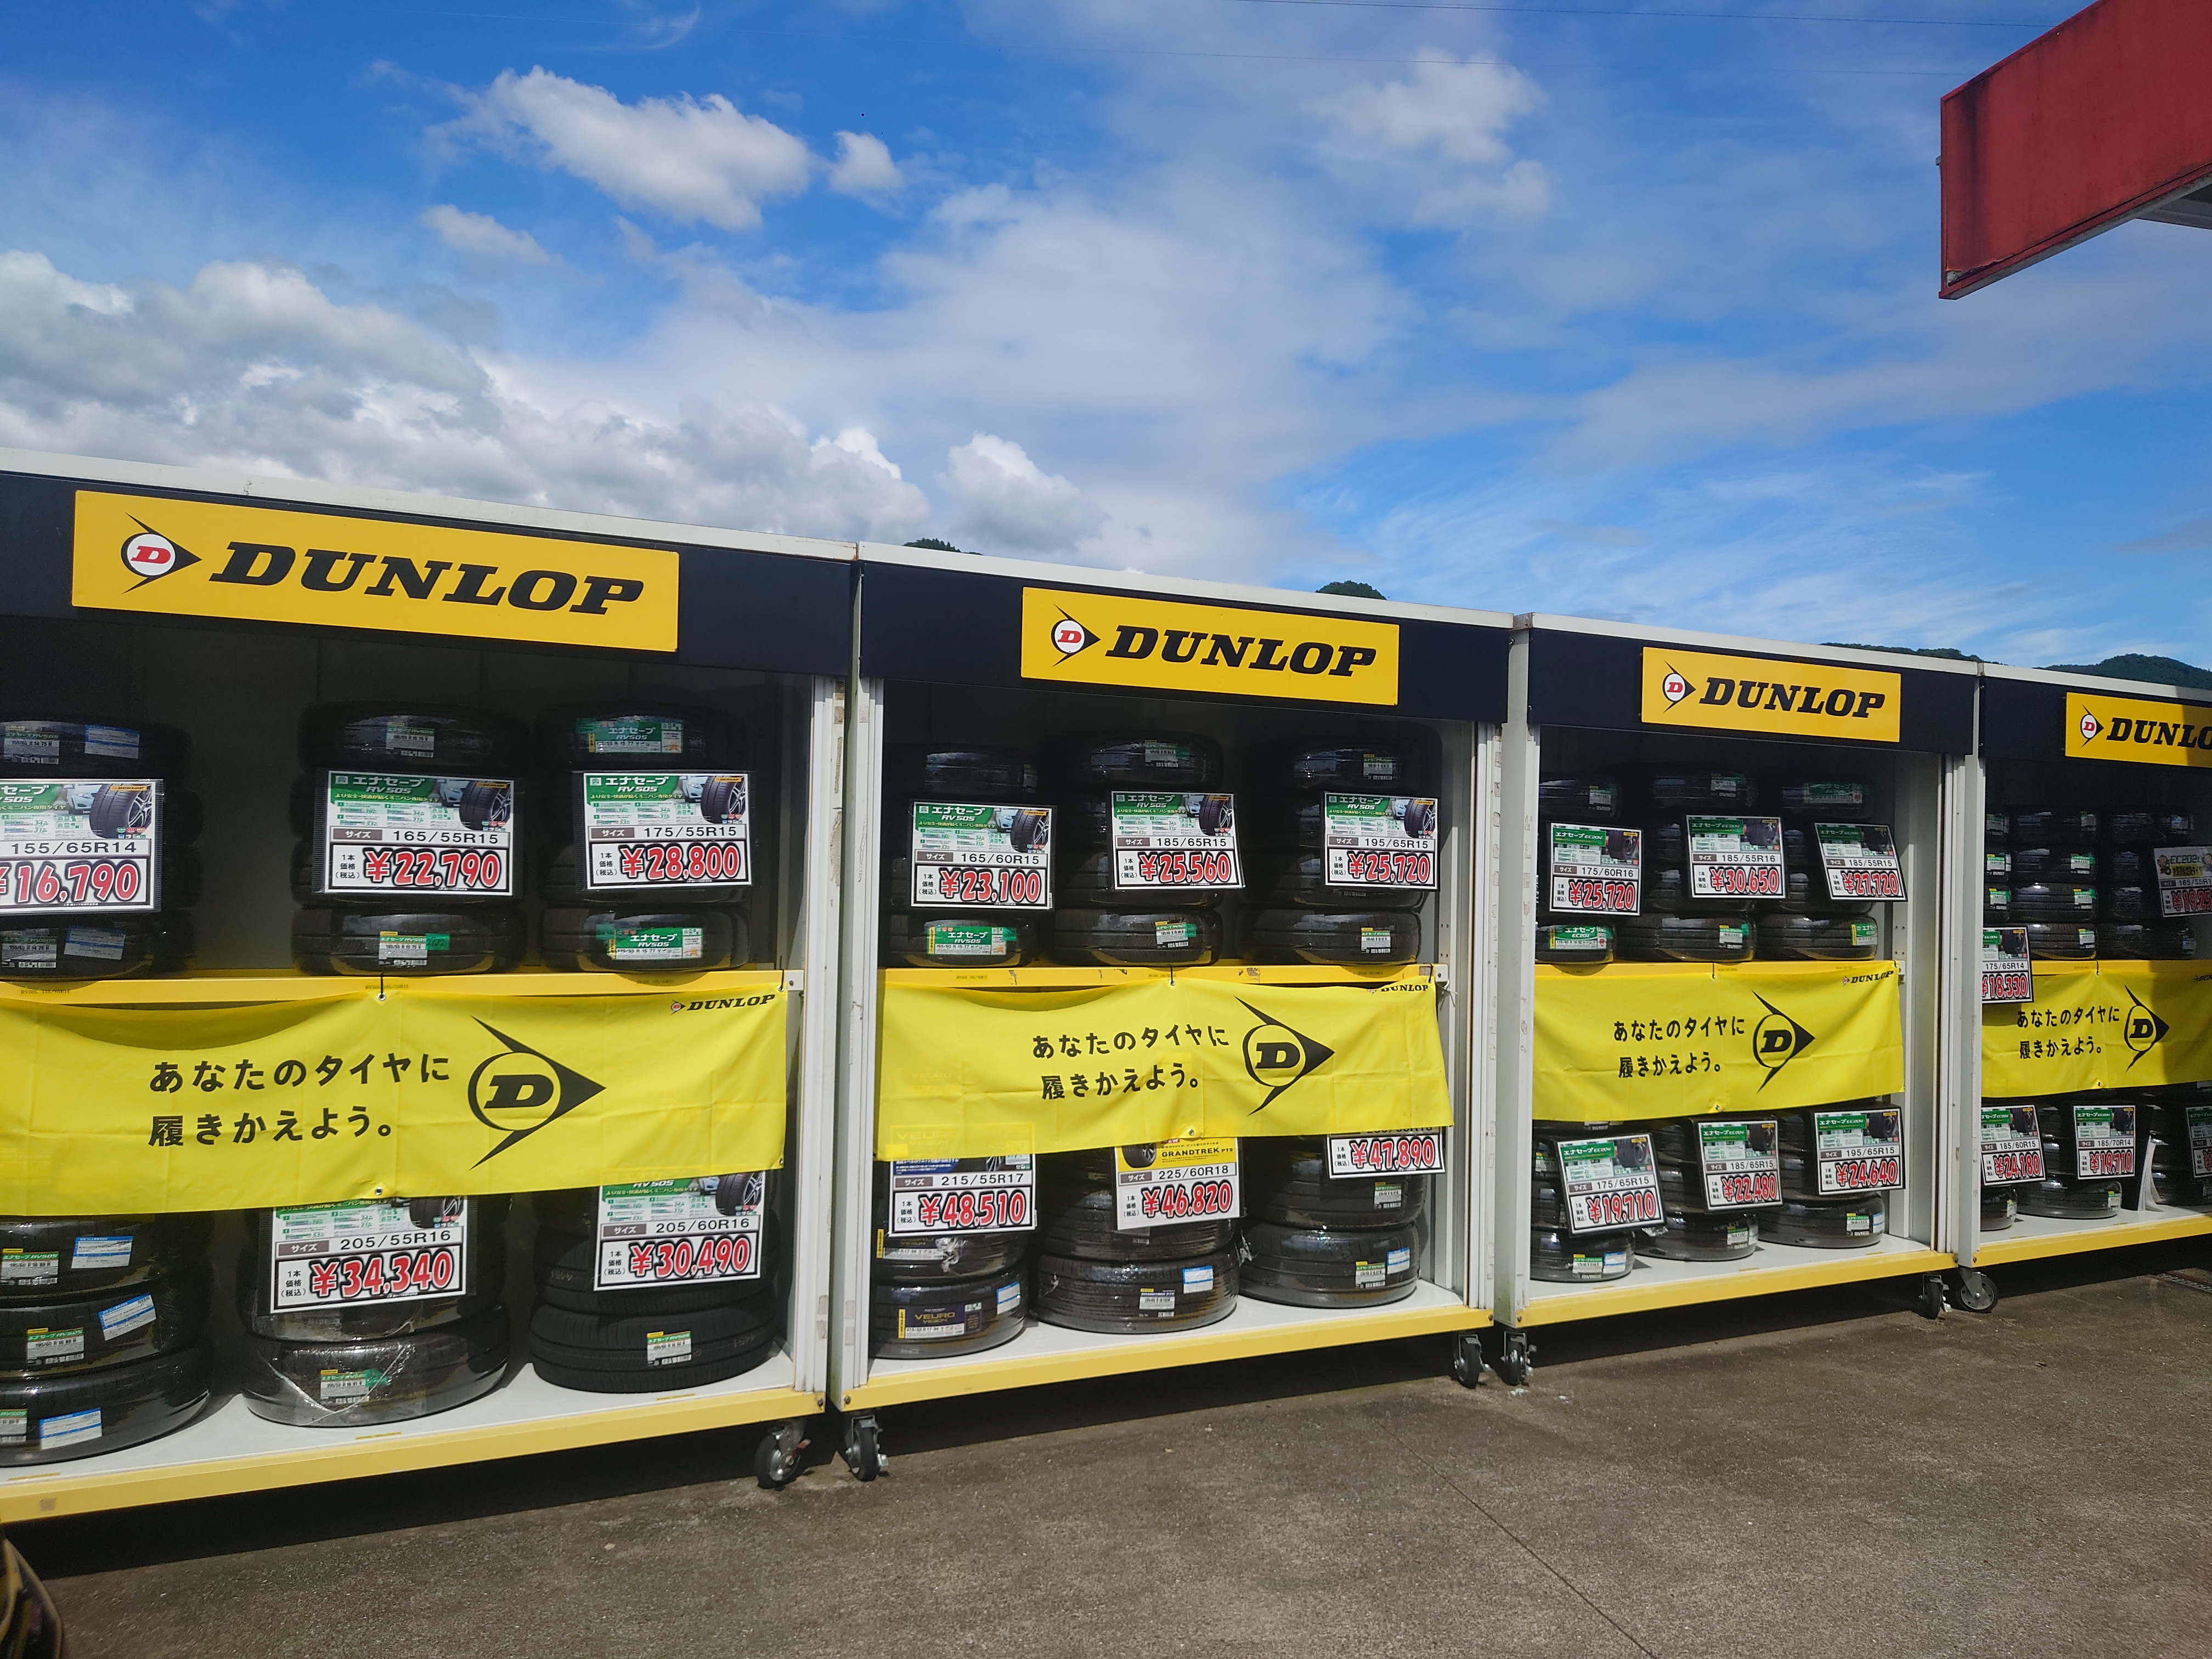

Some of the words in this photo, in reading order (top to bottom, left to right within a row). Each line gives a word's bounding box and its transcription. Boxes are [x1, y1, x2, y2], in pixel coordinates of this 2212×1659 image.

[209, 541, 644, 615] DUNLOP
[1105, 625, 1376, 676] DUNLOP
[1699, 676, 1886, 718] DUNLOP
[353, 777, 425, 787] エナセーブ
[605, 776, 669, 786] エナセーブ
[345, 830, 371, 838] サイズ
[393, 831, 498, 844] 165/55R15
[644, 827, 736, 837] 175/55R15
[1157, 838, 1227, 847] 185/65R15
[1365, 838, 1428, 849] 195/65R15
[12, 842, 137, 854] 155/65R14
[961, 854, 1039, 864] 165/60R15
[365, 851, 501, 887] ¥22,790
[620, 846, 740, 879] ¥28,800
[1139, 854, 1230, 882] ¥25,560
[1348, 854, 1429, 882] ¥25,720
[1582, 867, 1633, 877] 175/60R16
[940, 870, 1041, 902] ¥23,100
[1711, 869, 1779, 893] ¥30,650
[1842, 872, 1898, 895] ¥27,720
[1569, 881, 1634, 910] ¥25,720
[1380, 984, 1429, 992] DUNLOP
[1850, 970, 1894, 984] DUNLOP
[687, 994, 775, 1013] DUNLOP
[2017, 1006, 2119, 1028] あなたのタイヤに
[2129, 1018, 2153, 1039] D
[1032, 1023, 1230, 1058] あなたのタイヤに
[1613, 1016, 1745, 1042] あなたのタイヤに
[1759, 1029, 1793, 1053] D
[2020, 1036, 2102, 1059] 履きかえよう。
[1254, 1041, 1300, 1069] D
[1618, 1051, 1722, 1079] 履きかえよう。
[149, 1053, 450, 1093] あなたのタイヤに
[1041, 1062, 1199, 1101] 履きかえよう。
[483, 1074, 554, 1108] D
[148, 1105, 392, 1147] 履きかえよう。
[1162, 1148, 1220, 1157] GRANDTREK
[1351, 1138, 1435, 1169] ¥47,890
[1847, 1147, 1895, 1157] 195/65R15
[2000, 1141, 2036, 1150] 185/60R15
[1159, 1165, 1229, 1180] 225/60R18
[1730, 1161, 1773, 1170] 185/65R15
[1837, 1160, 1897, 1187] ¥24,640
[1994, 1154, 2040, 1178] ¥24,180
[2090, 1152, 2131, 1174] ¥19,710
[941, 1173, 1024, 1186] 215/55R17
[1597, 1178, 1649, 1189] 175/65R15
[1722, 1175, 1776, 1202] ¥22,480
[920, 1192, 1025, 1227] ¥48,510
[1142, 1182, 1231, 1218] ¥46,820
[1587, 1192, 1655, 1222] ¥19,710
[614, 1226, 636, 1234] サイズ
[656, 1218, 749, 1233] 205/60R16
[291, 1243, 318, 1252] サイズ
[340, 1230, 451, 1250] 205/55R16
[631, 1237, 750, 1278] ¥30,490
[286, 1279, 302, 1288] 価格
[312, 1251, 453, 1297] ¥34,340
[915, 1311, 956, 1319] VEURO
